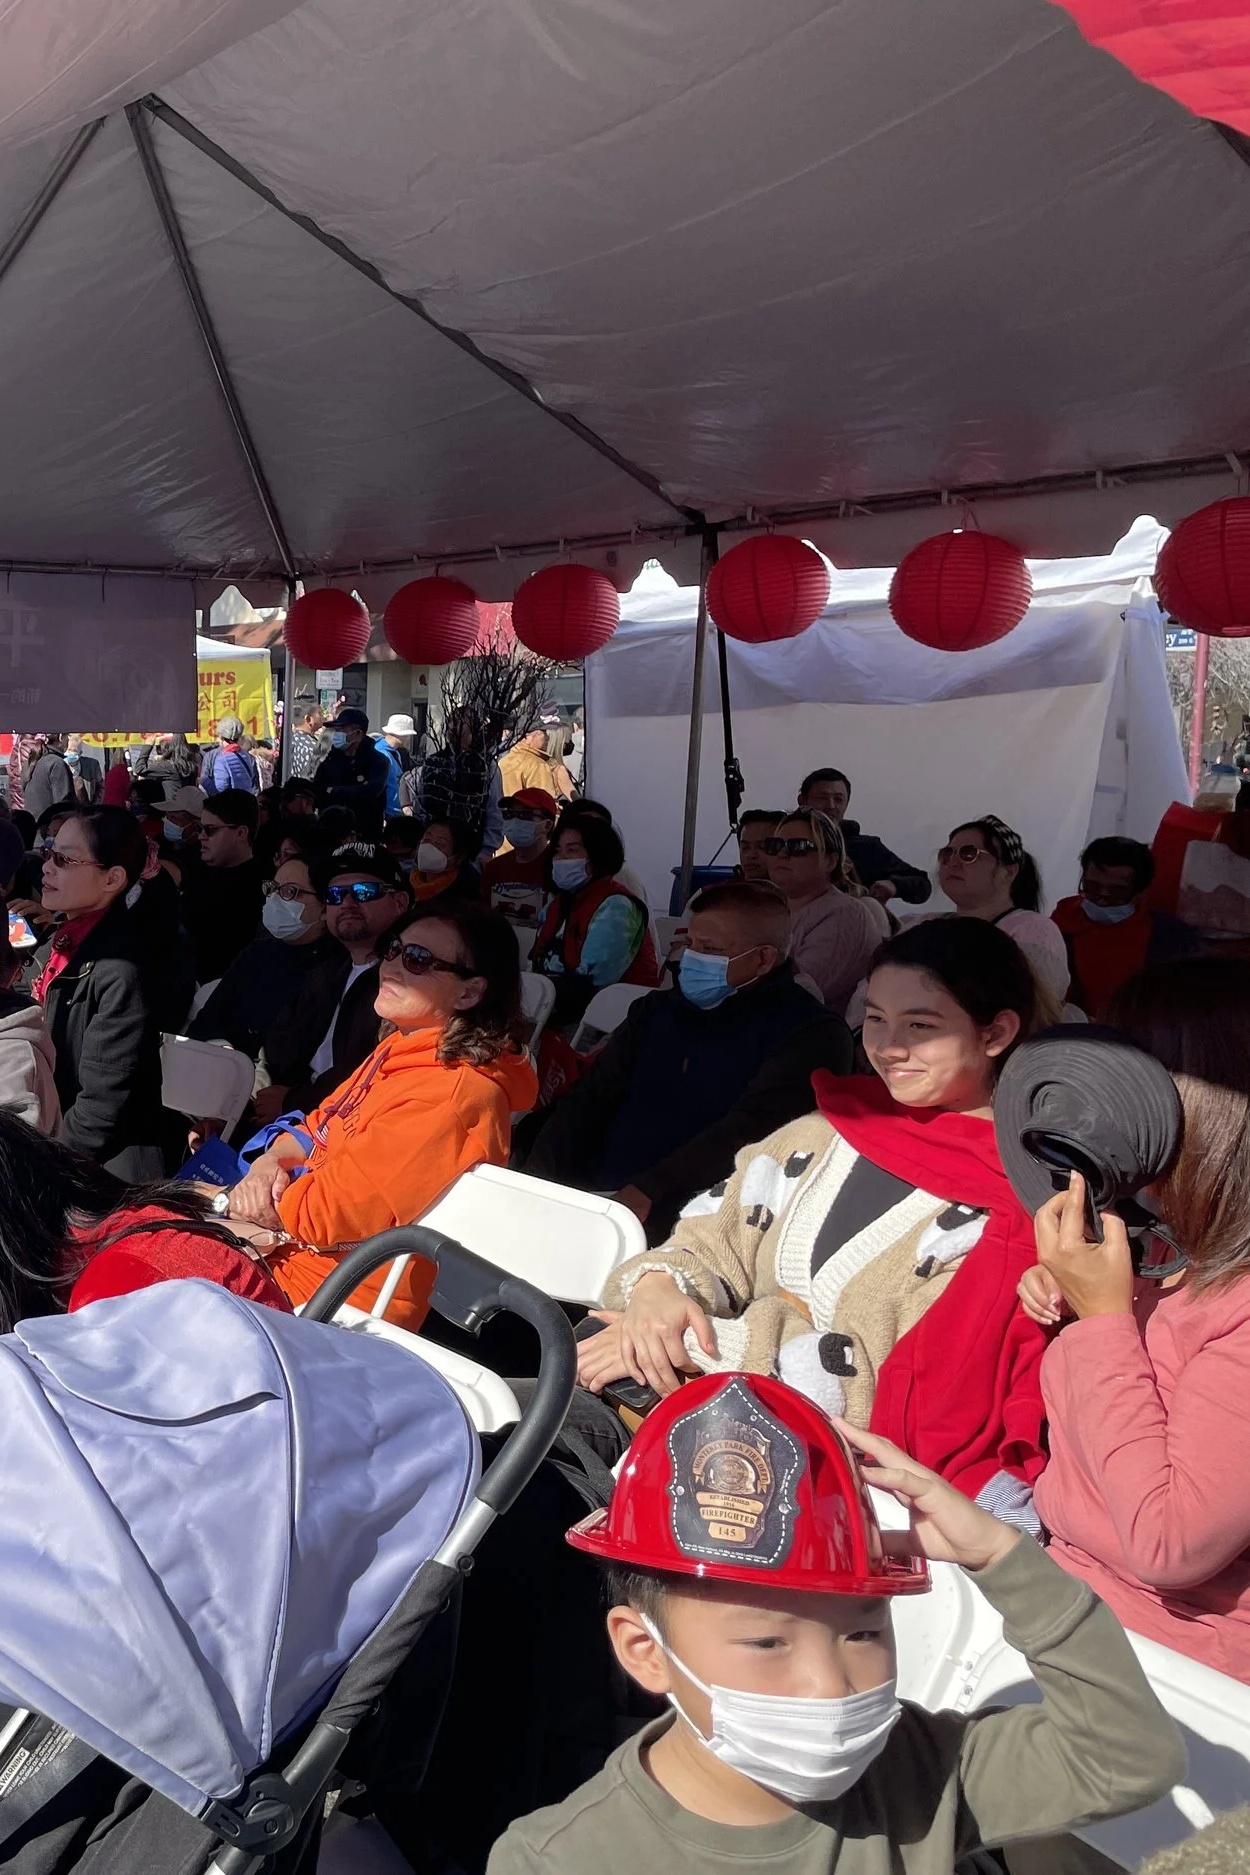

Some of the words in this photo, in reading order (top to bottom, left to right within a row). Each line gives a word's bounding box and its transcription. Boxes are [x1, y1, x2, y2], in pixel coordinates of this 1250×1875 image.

[694, 1442, 723, 1470] MONTEREY
[724, 1441, 744, 1452] PARK
[745, 1448, 760, 1463] FIRE
[710, 1494, 750, 1506] ESTABLISHED
[702, 1509, 756, 1525] FIREFIGHTER
[718, 1527, 736, 1536] 145
[0, 1750, 26, 1784] WARNING
